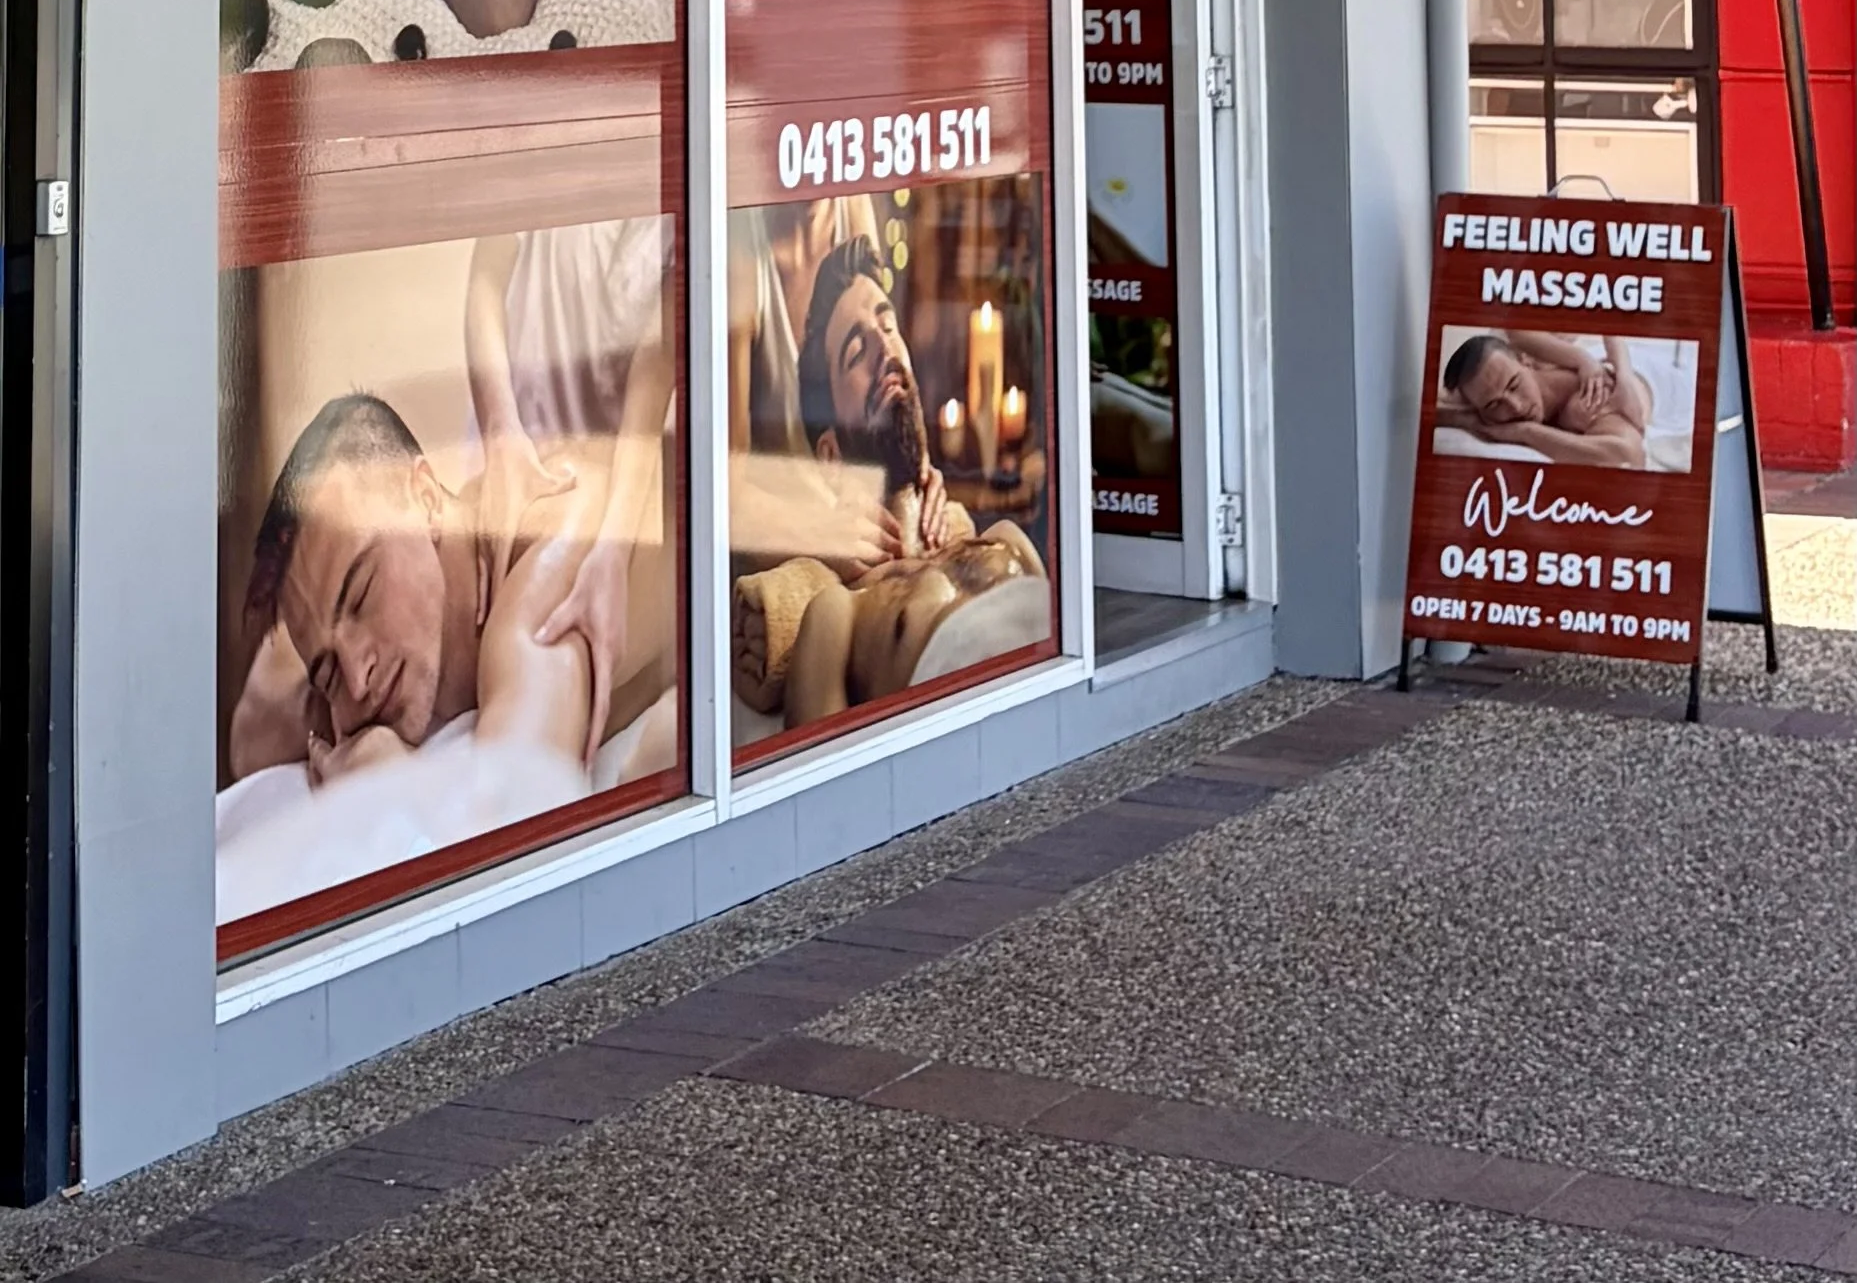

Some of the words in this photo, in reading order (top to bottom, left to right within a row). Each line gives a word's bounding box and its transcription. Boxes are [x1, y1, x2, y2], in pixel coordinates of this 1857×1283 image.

[1083, 8, 1142, 46] 511
[1085, 61, 1113, 85] TO
[1117, 61, 1164, 86] 9PM
[777, 117, 866, 189] 0413
[871, 111, 932, 178] 581
[938, 105, 991, 171] 511
[1443, 213, 1596, 256] FEELING
[1606, 221, 1713, 262] WELL
[1481, 267, 1664, 313] MASSAGE
[1463, 467, 1654, 538] Welcome
[1440, 545, 1529, 583] 0413
[1535, 552, 1603, 589] 581
[1611, 557, 1672, 595] 511
[1411, 595, 1467, 620] OPEN
[1471, 601, 1485, 622] 7
[1487, 603, 1542, 628] DAYS
[1559, 610, 1606, 634] 9AM
[1611, 614, 1638, 637] TO
[1643, 617, 1691, 642] 9PM
